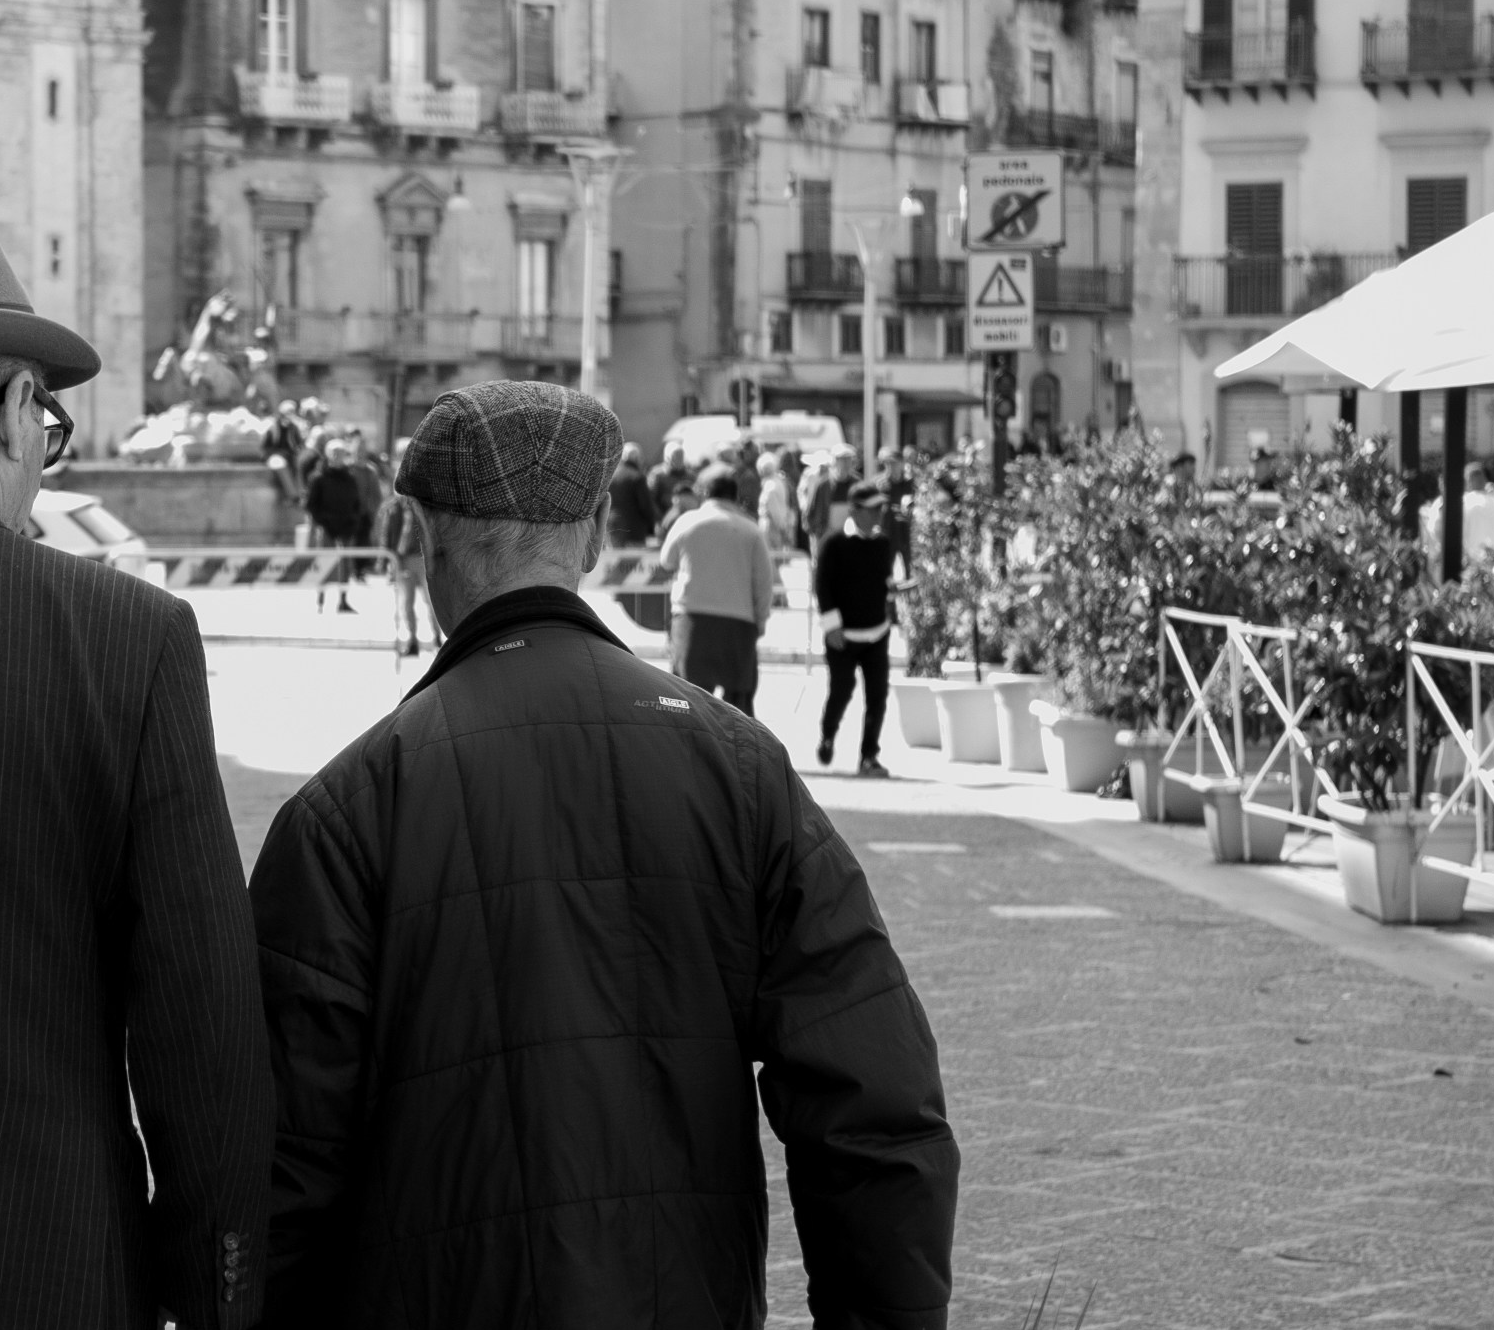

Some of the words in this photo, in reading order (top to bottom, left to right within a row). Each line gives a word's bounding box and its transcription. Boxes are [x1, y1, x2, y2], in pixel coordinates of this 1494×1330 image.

[983, 174, 1044, 188] pedonale
[495, 640, 524, 651] AIGLE
[660, 697, 689, 709] AIGLE
